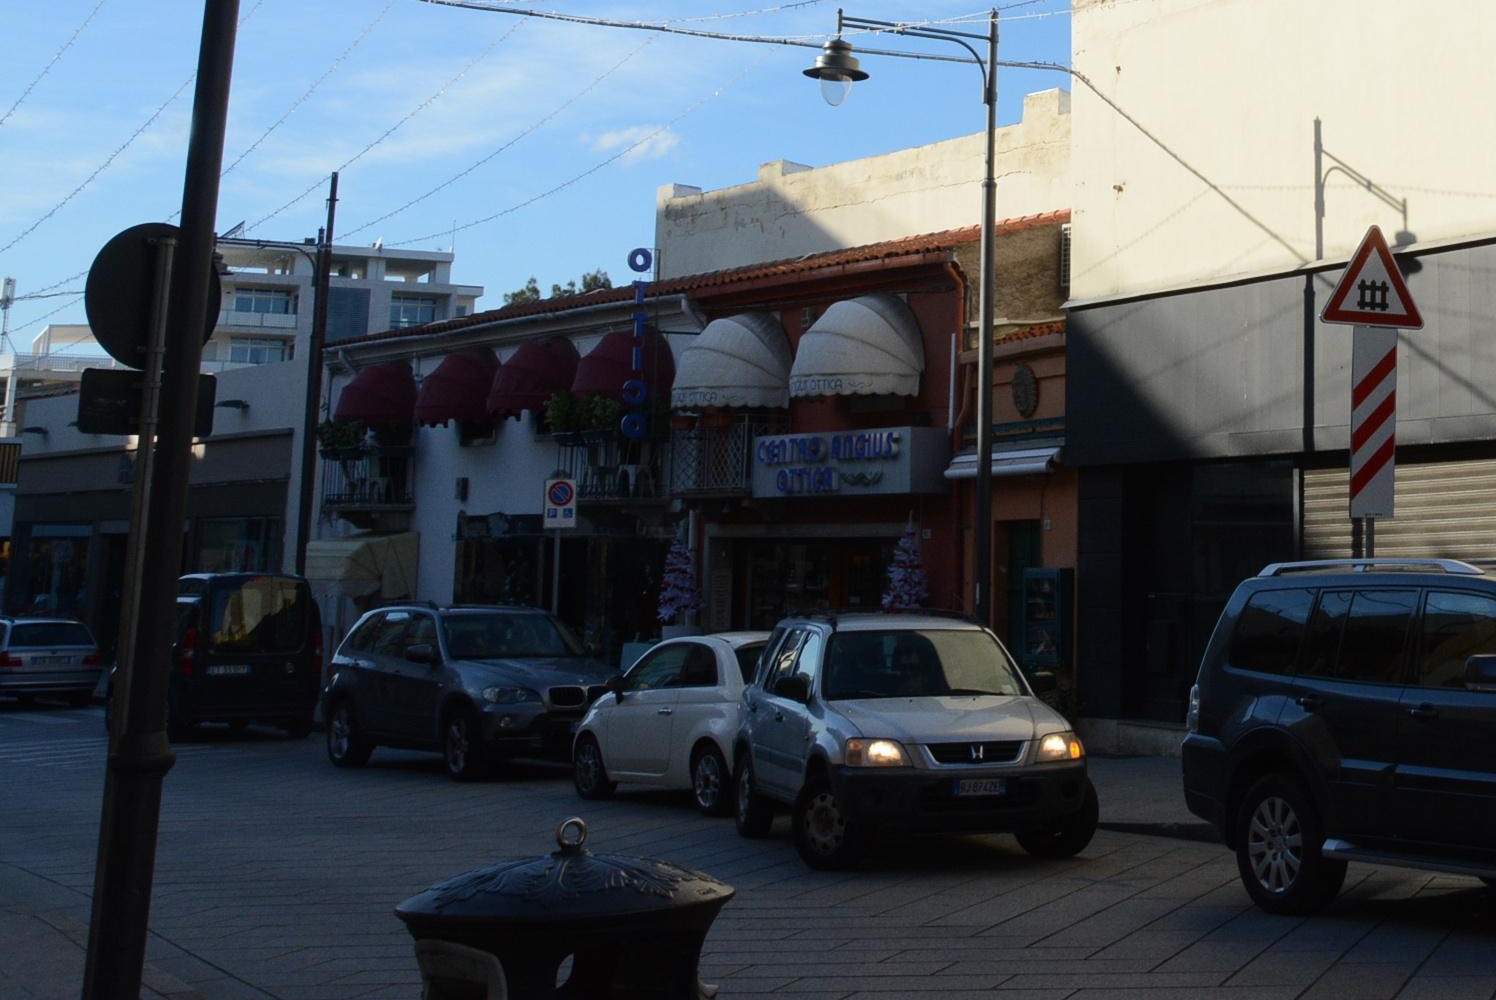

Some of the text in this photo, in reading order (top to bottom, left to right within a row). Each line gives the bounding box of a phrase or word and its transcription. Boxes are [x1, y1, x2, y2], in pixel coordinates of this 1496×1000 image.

[758, 432, 900, 463] CENTRO ANGIUS
[776, 466, 838, 492] OTTICA
